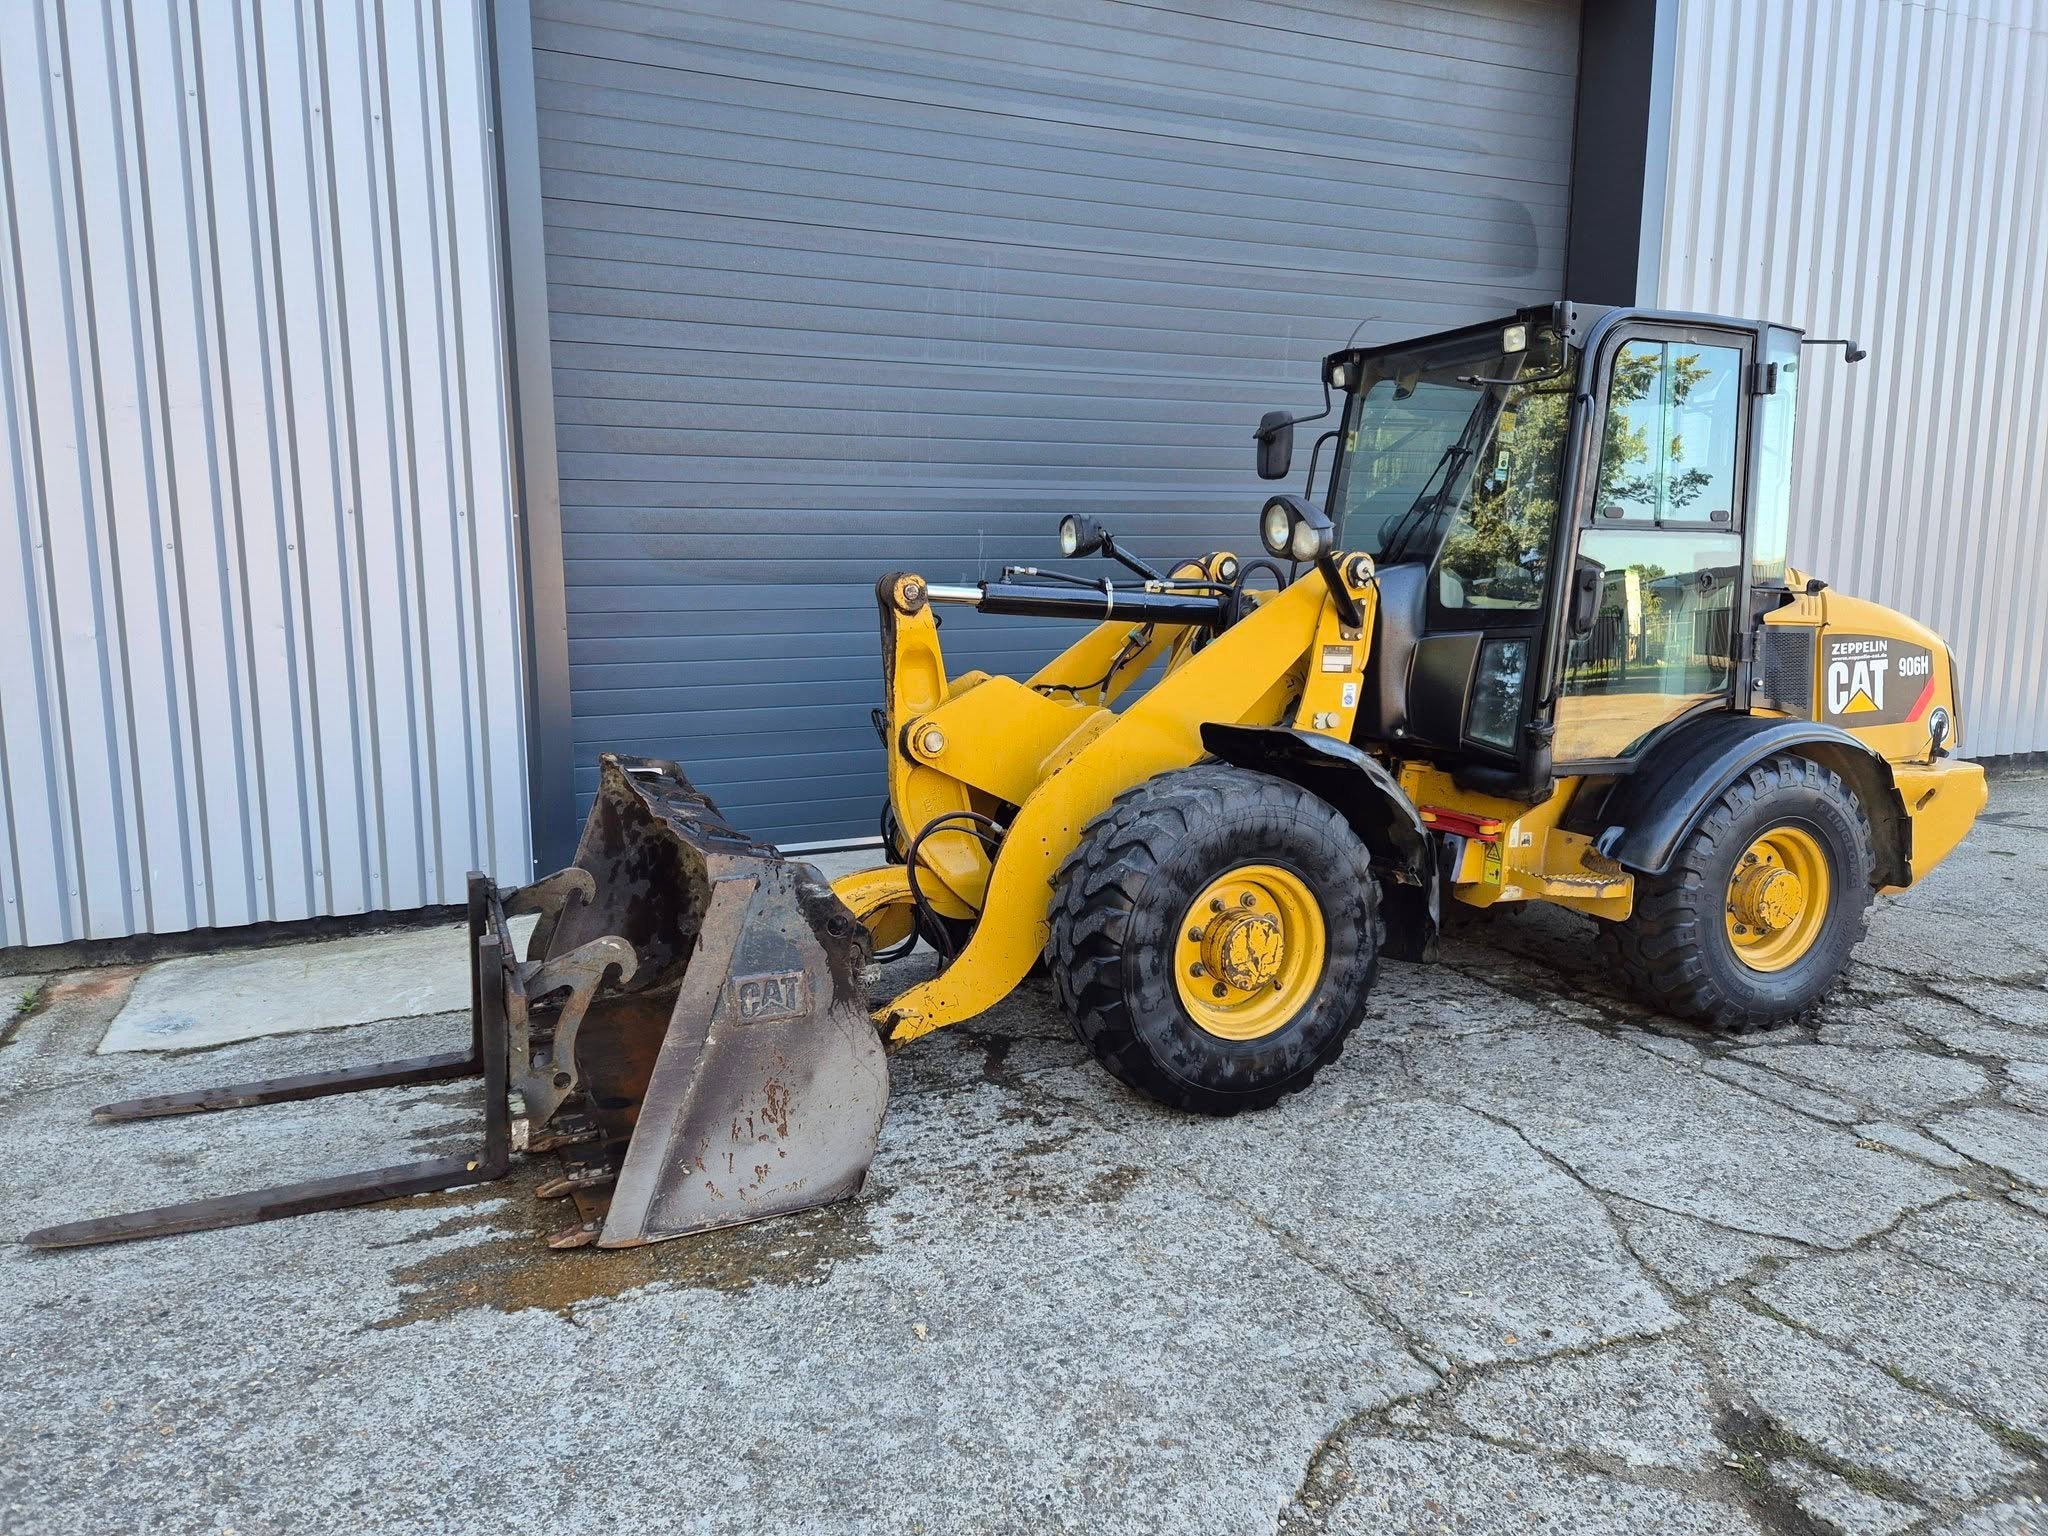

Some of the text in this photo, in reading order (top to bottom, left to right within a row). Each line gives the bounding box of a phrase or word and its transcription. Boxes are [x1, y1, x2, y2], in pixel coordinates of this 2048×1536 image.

[1831, 640, 1888, 655] ZEPPELIN
[1899, 655, 1929, 677] 906H
[1828, 659, 1889, 715] CAT
[740, 976, 799, 1019] CAT
